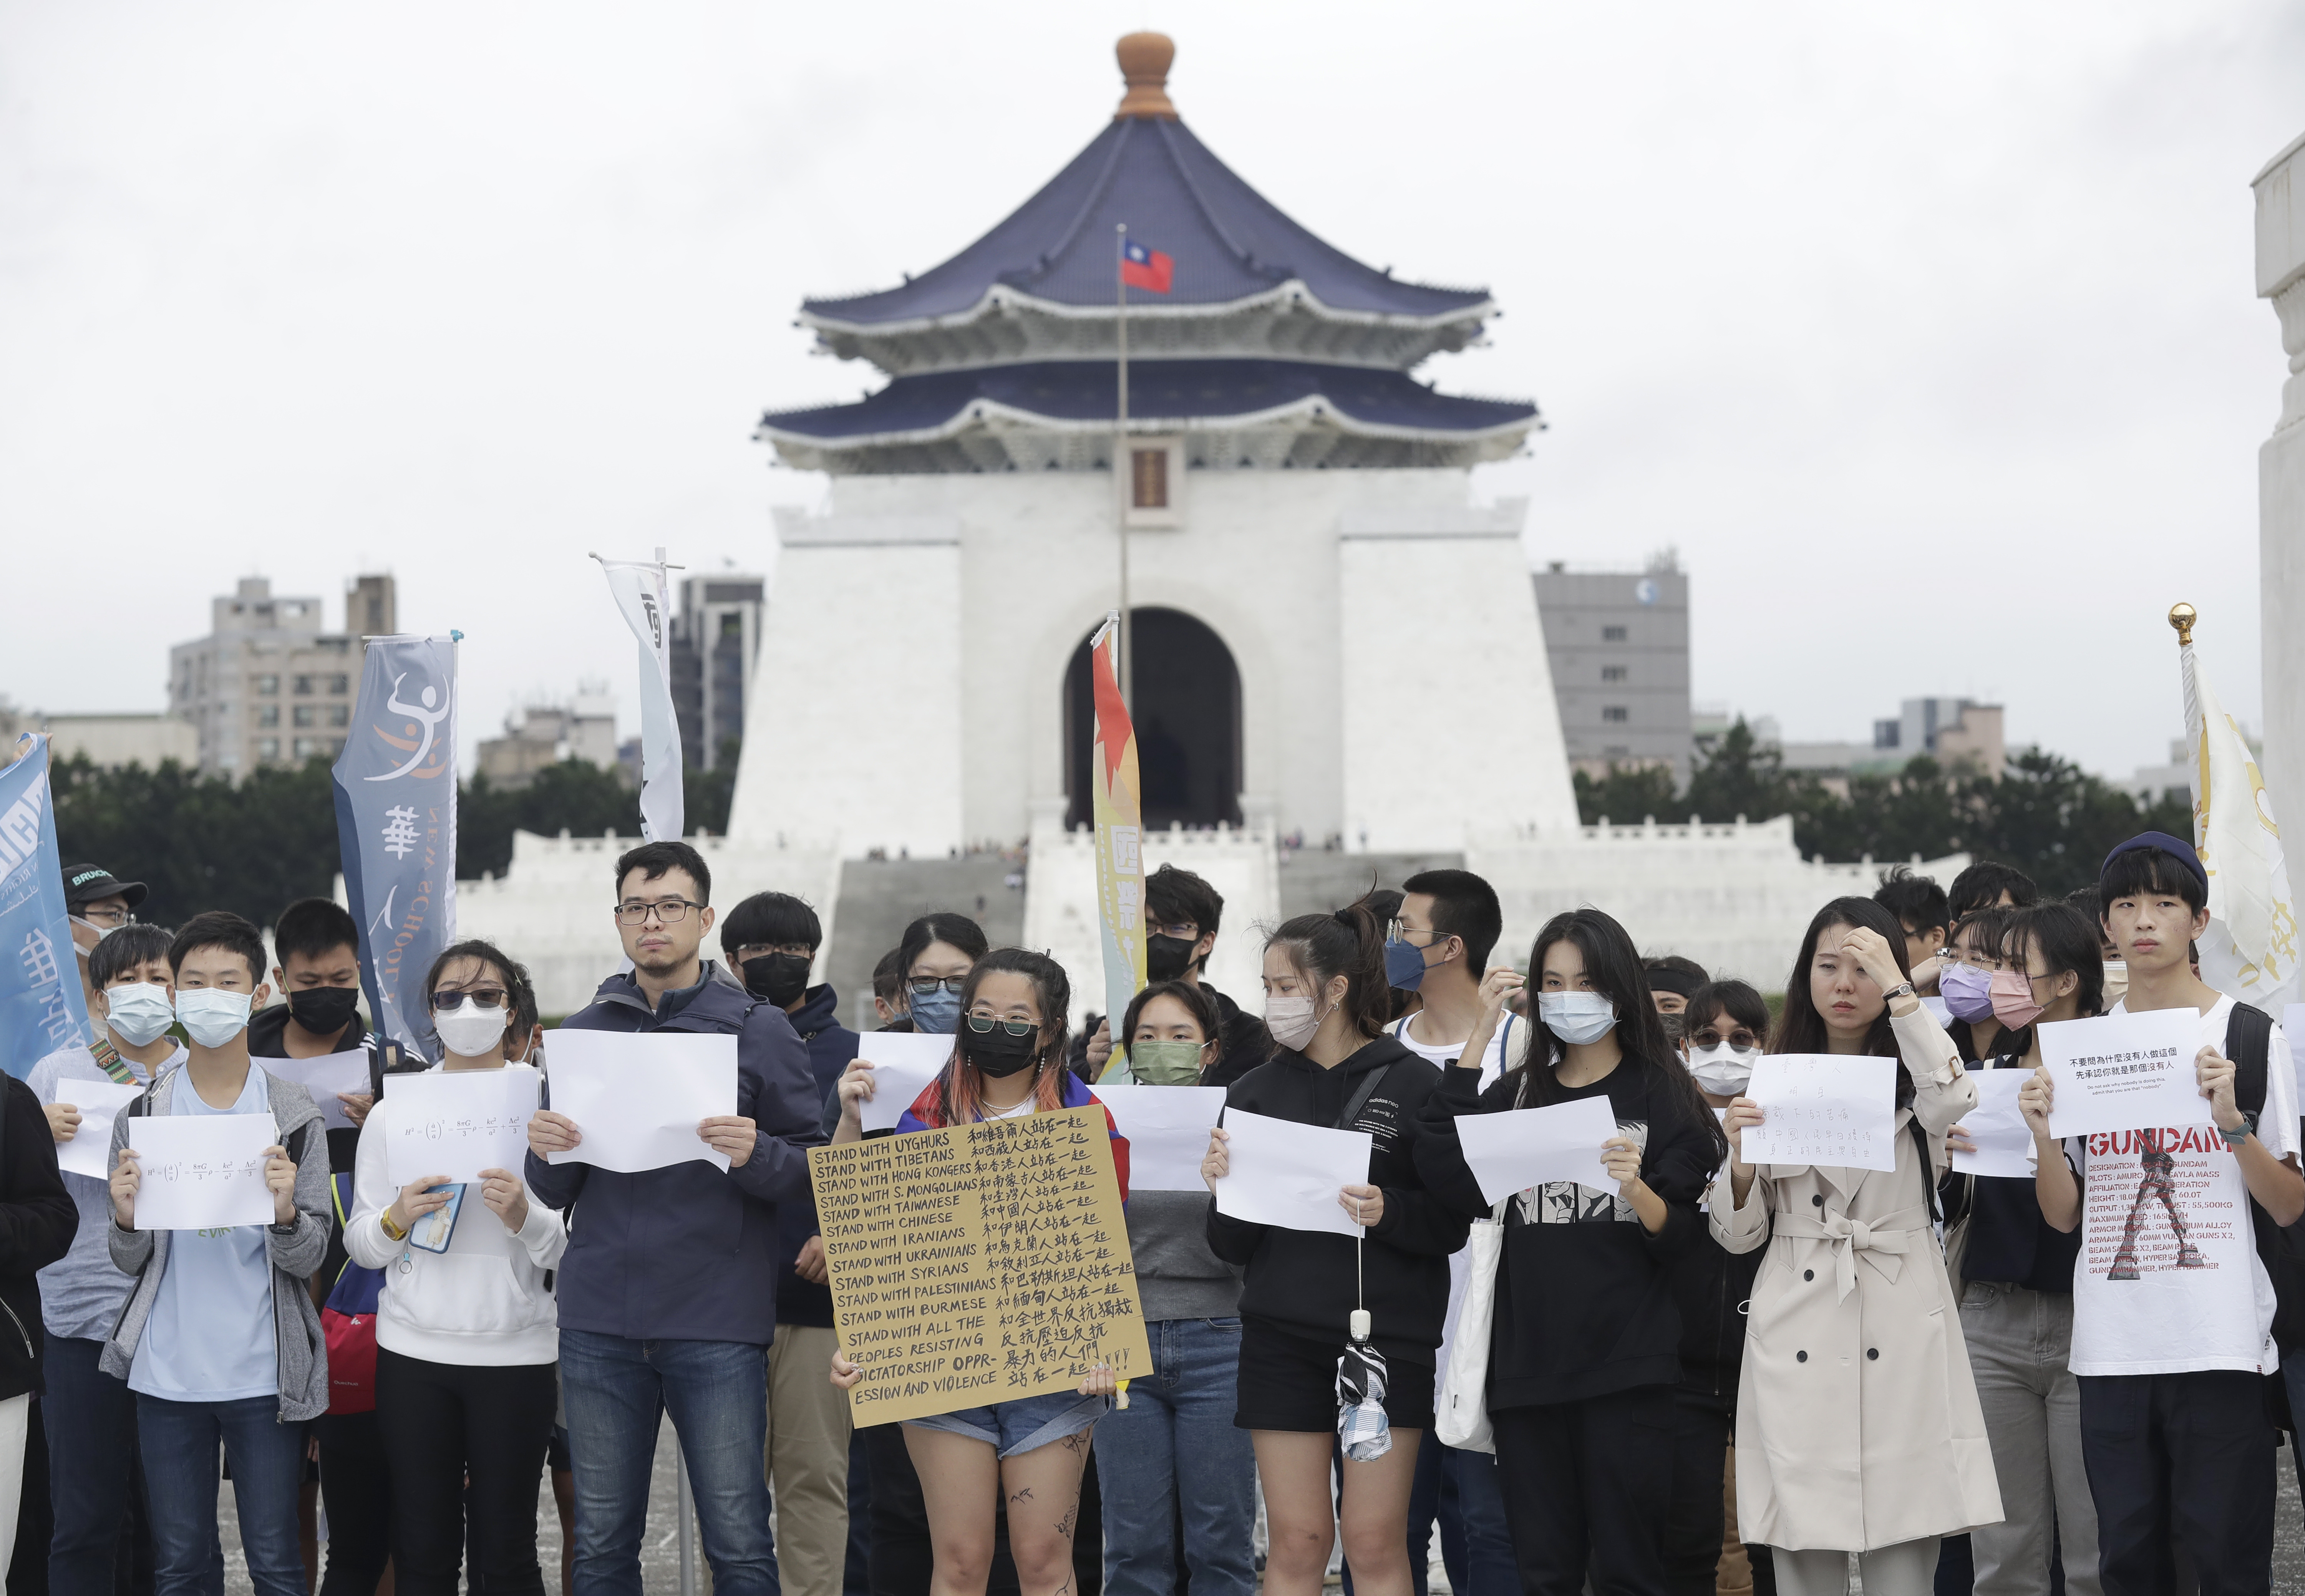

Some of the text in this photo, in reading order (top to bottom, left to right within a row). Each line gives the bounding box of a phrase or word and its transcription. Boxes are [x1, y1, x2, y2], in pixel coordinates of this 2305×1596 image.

[2070, 1047, 2177, 1067] 不要問為什麼沒有人做這個
[2076, 1061, 2174, 1080] 先承認你就是那個沒有人
[967, 1114, 1088, 1144] 和維吾爾人站在一起
[2089, 1127, 2233, 1157] GUNDAM
[815, 1132, 950, 1164] STAND WITH UYGHURS
[971, 1132, 1089, 1158] 和西藏人站在一起
[816, 1148, 954, 1178] STAND WITH TIBETANS
[974, 1148, 1092, 1175] 和香港人站在一起
[2088, 1162, 2135, 1172] DESIGNATION
[817, 1163, 971, 1193] STAND WITH HONG KONGERS
[978, 1165, 1097, 1192] 和南蒙古人站在一起
[2089, 1173, 2112, 1182] PILOTS
[2116, 1172, 2143, 1180] AMURO
[2089, 1183, 2129, 1192] AFFILIATION
[820, 1178, 978, 1208] STAND WITH S. MONGOLIANS
[2089, 1195, 2115, 1203] HEIGHT
[823, 1195, 960, 1223] STAND WITH TAIWANESE
[980, 1195, 1098, 1221] 和中國人站在一起
[2089, 1205, 2117, 1213] OUTPUT
[827, 1212, 952, 1238] STAND WITH CHINESE
[982, 1212, 1102, 1240] 和伊朗人站在一起
[828, 1227, 965, 1255] STAND WITH IRANIANS
[984, 1230, 1111, 1256] 和烏克蘭人站在一起
[832, 1243, 977, 1273] STAND WITH UKRAINIANS
[835, 1262, 968, 1291] STAND WITH SYRIANS
[1001, 1260, 1135, 1296] 和巴勒斯坦人站在一起
[837, 1277, 996, 1307] STAND WITH PALESTINIANS
[995, 1282, 1124, 1311] 和緬甸人站在一起
[841, 1297, 987, 1326] STAND WITH BURMESE
[999, 1298, 1133, 1329] 和全世界反抗獨裁
[848, 1315, 985, 1347] STAND WITH ALL THE
[1001, 1321, 1108, 1349] 反抗壓迫反抗
[849, 1333, 983, 1363] PEOPLES RESISTING
[1003, 1340, 1099, 1371] 暴力的人們
[953, 1354, 997, 1371] OPPR-
[856, 1371, 997, 1405] ESSION AND VIOLENCE
